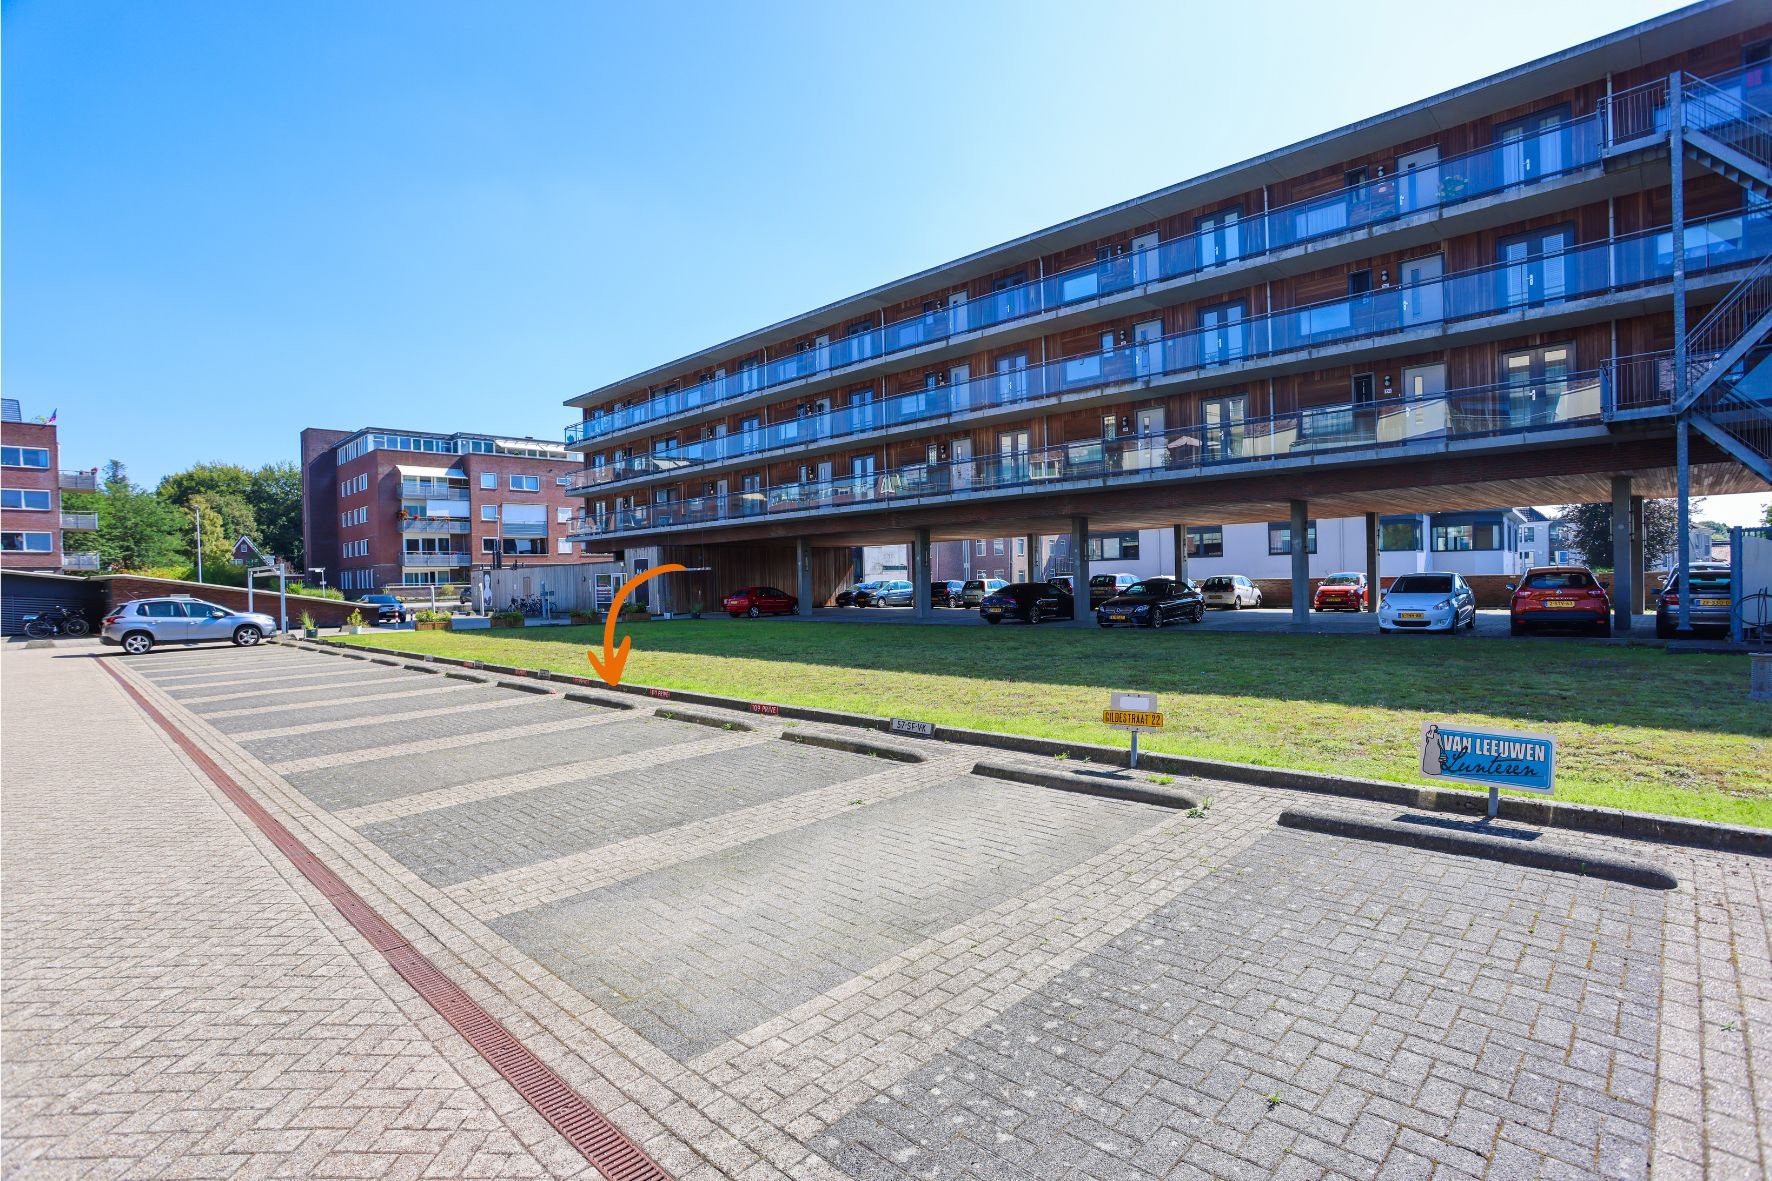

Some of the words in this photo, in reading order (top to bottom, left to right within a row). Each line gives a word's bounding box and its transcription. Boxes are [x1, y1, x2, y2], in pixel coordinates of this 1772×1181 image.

[1105, 711, 1149, 725] GILDESTRAAT
[1151, 714, 1161, 726] 22
[1440, 745, 1538, 776] Lunteren
[1443, 734, 1472, 754] VAN
[1475, 738, 1545, 762] LEEUWEN
